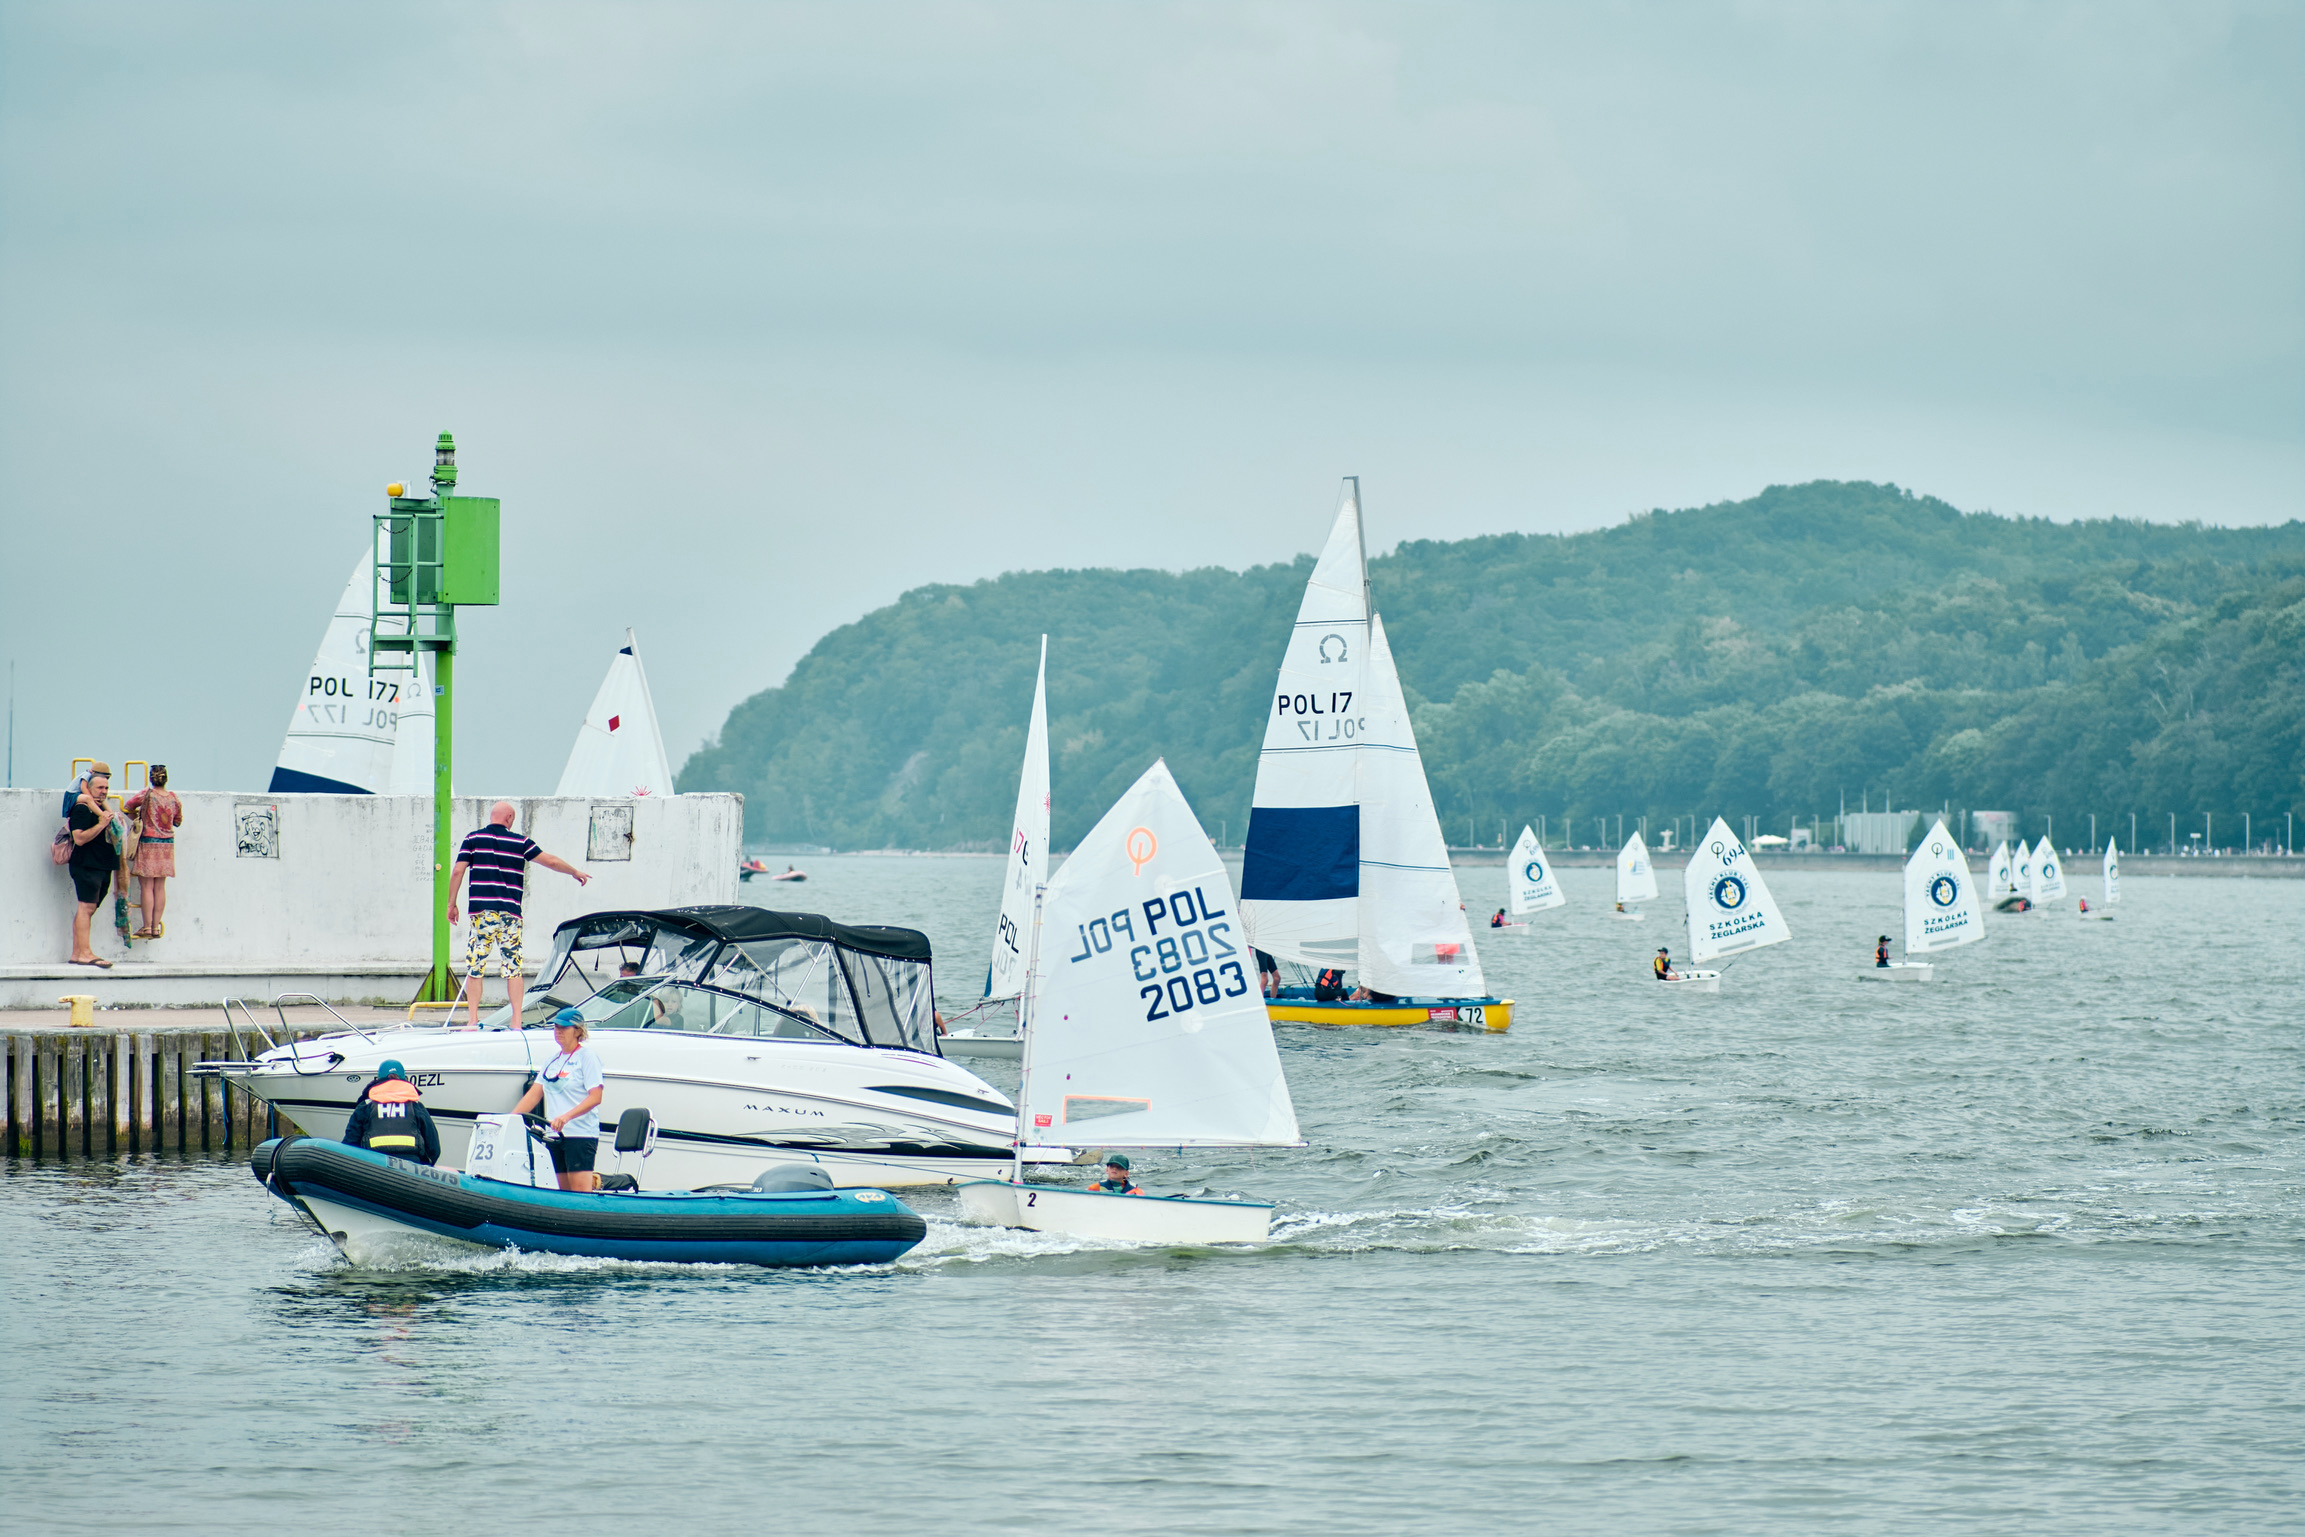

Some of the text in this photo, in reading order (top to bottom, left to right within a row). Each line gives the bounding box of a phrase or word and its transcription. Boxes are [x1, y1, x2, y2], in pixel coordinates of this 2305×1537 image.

[310, 676, 399, 703] POL 177
[1278, 691, 1352, 716] POL 17
[1142, 886, 1226, 936] POL
[998, 913, 1019, 954] POL
[1140, 961, 1248, 1022] 2083
[1465, 1007, 1483, 1024] 72
[377, 1102, 406, 1119] HH
[743, 1104, 825, 1117] MAXUM
[474, 1143, 494, 1160] 23
[387, 1156, 408, 1171] PL
[412, 1164, 458, 1186] 12675
[1026, 1192, 1037, 1208] 2
